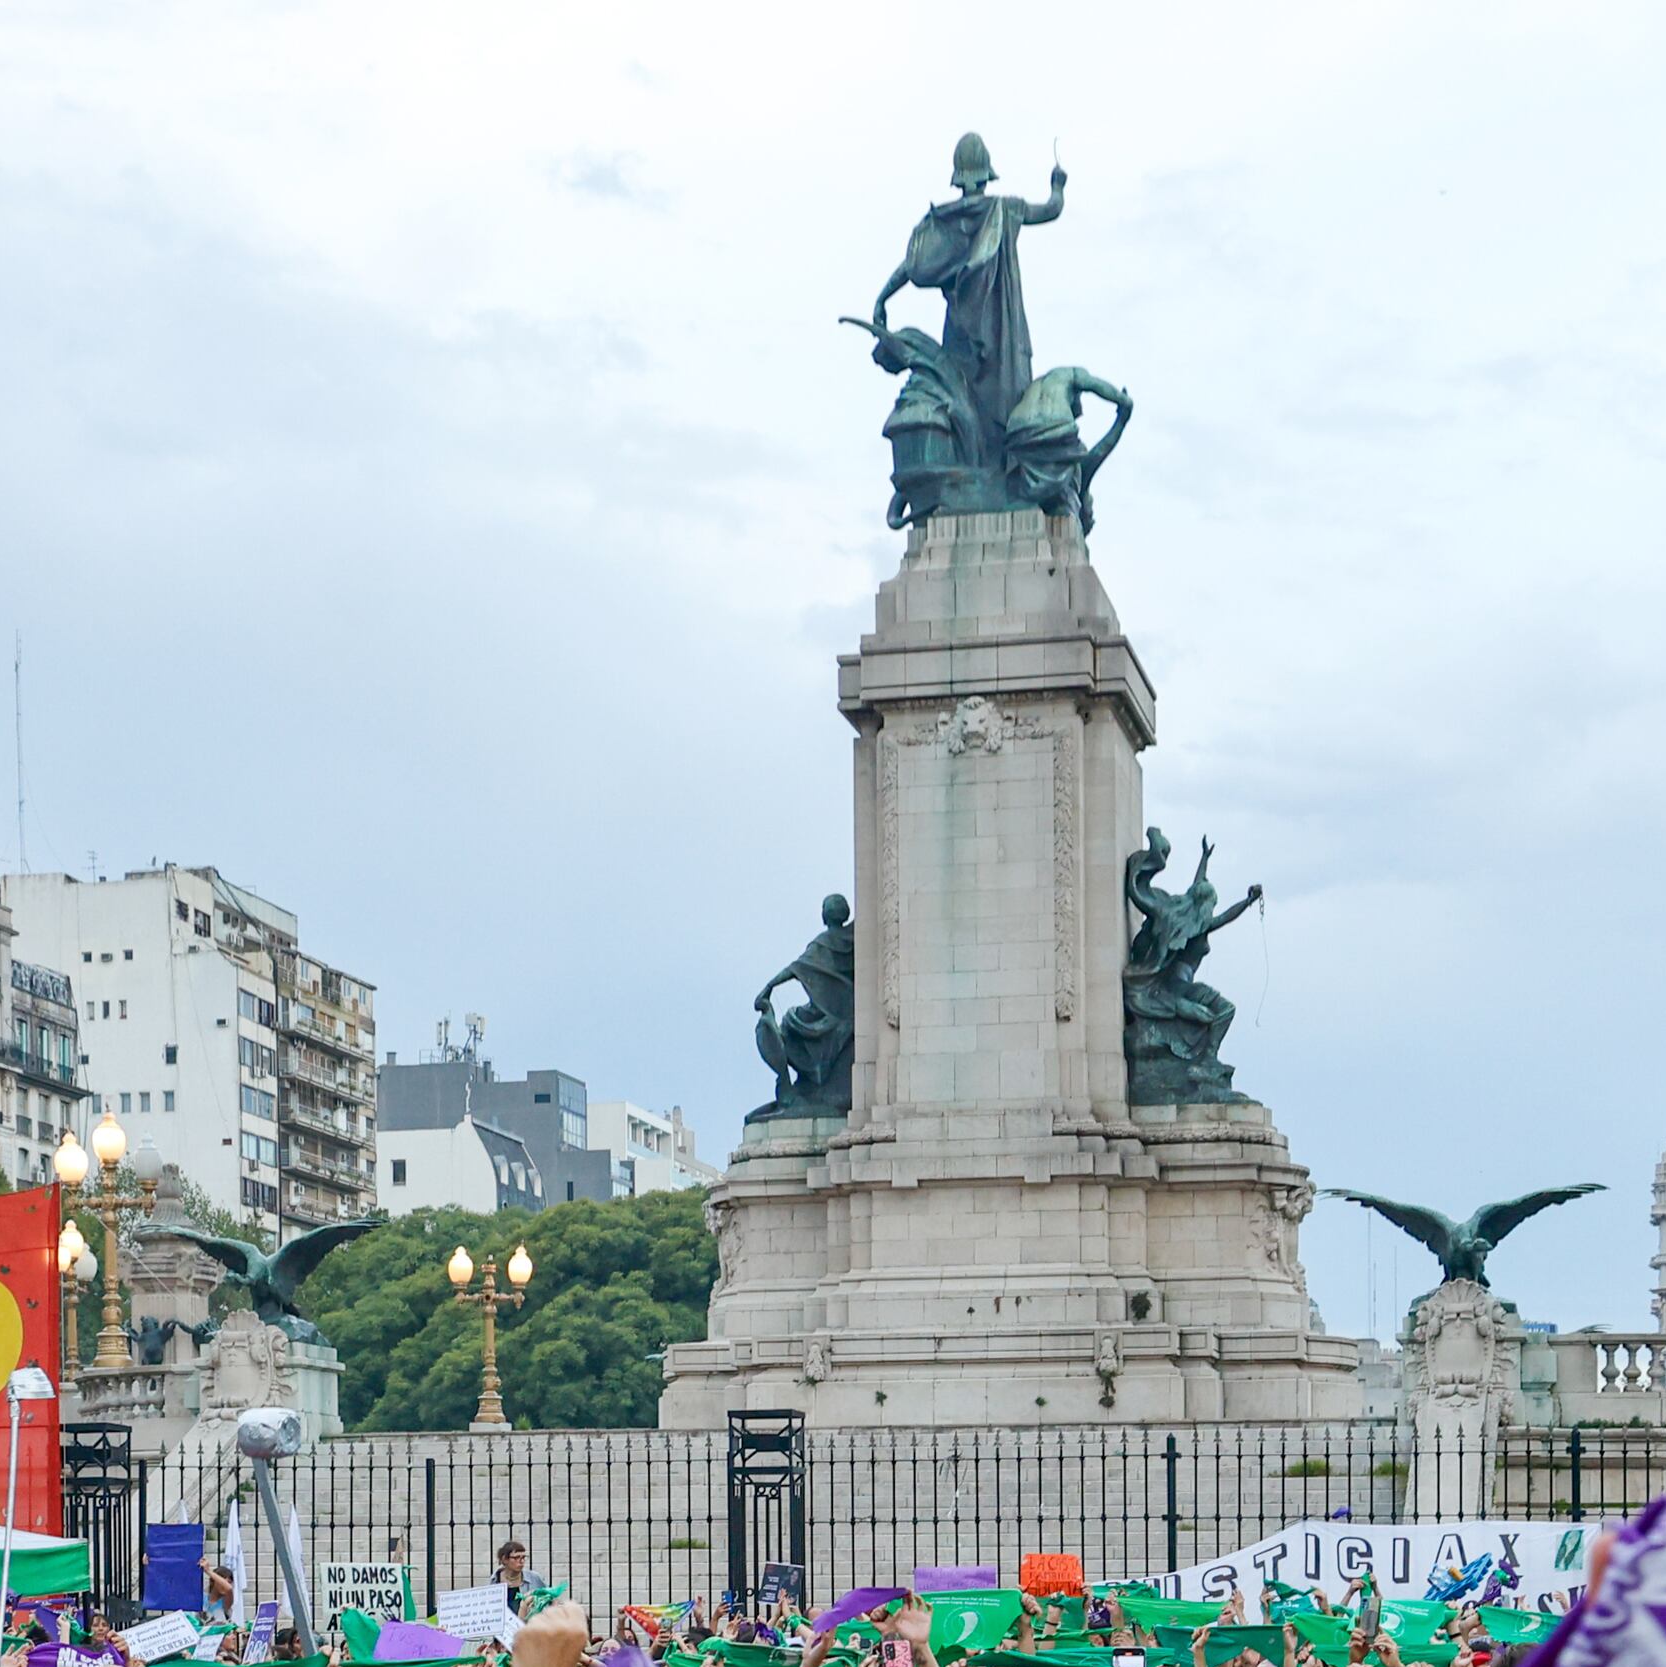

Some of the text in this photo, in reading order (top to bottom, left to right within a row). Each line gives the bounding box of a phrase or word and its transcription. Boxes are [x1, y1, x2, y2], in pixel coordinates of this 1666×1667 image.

[328, 1566, 398, 1584] NO DAMOS
[345, 1590, 365, 1608] UN
[369, 1589, 403, 1608] PASO
